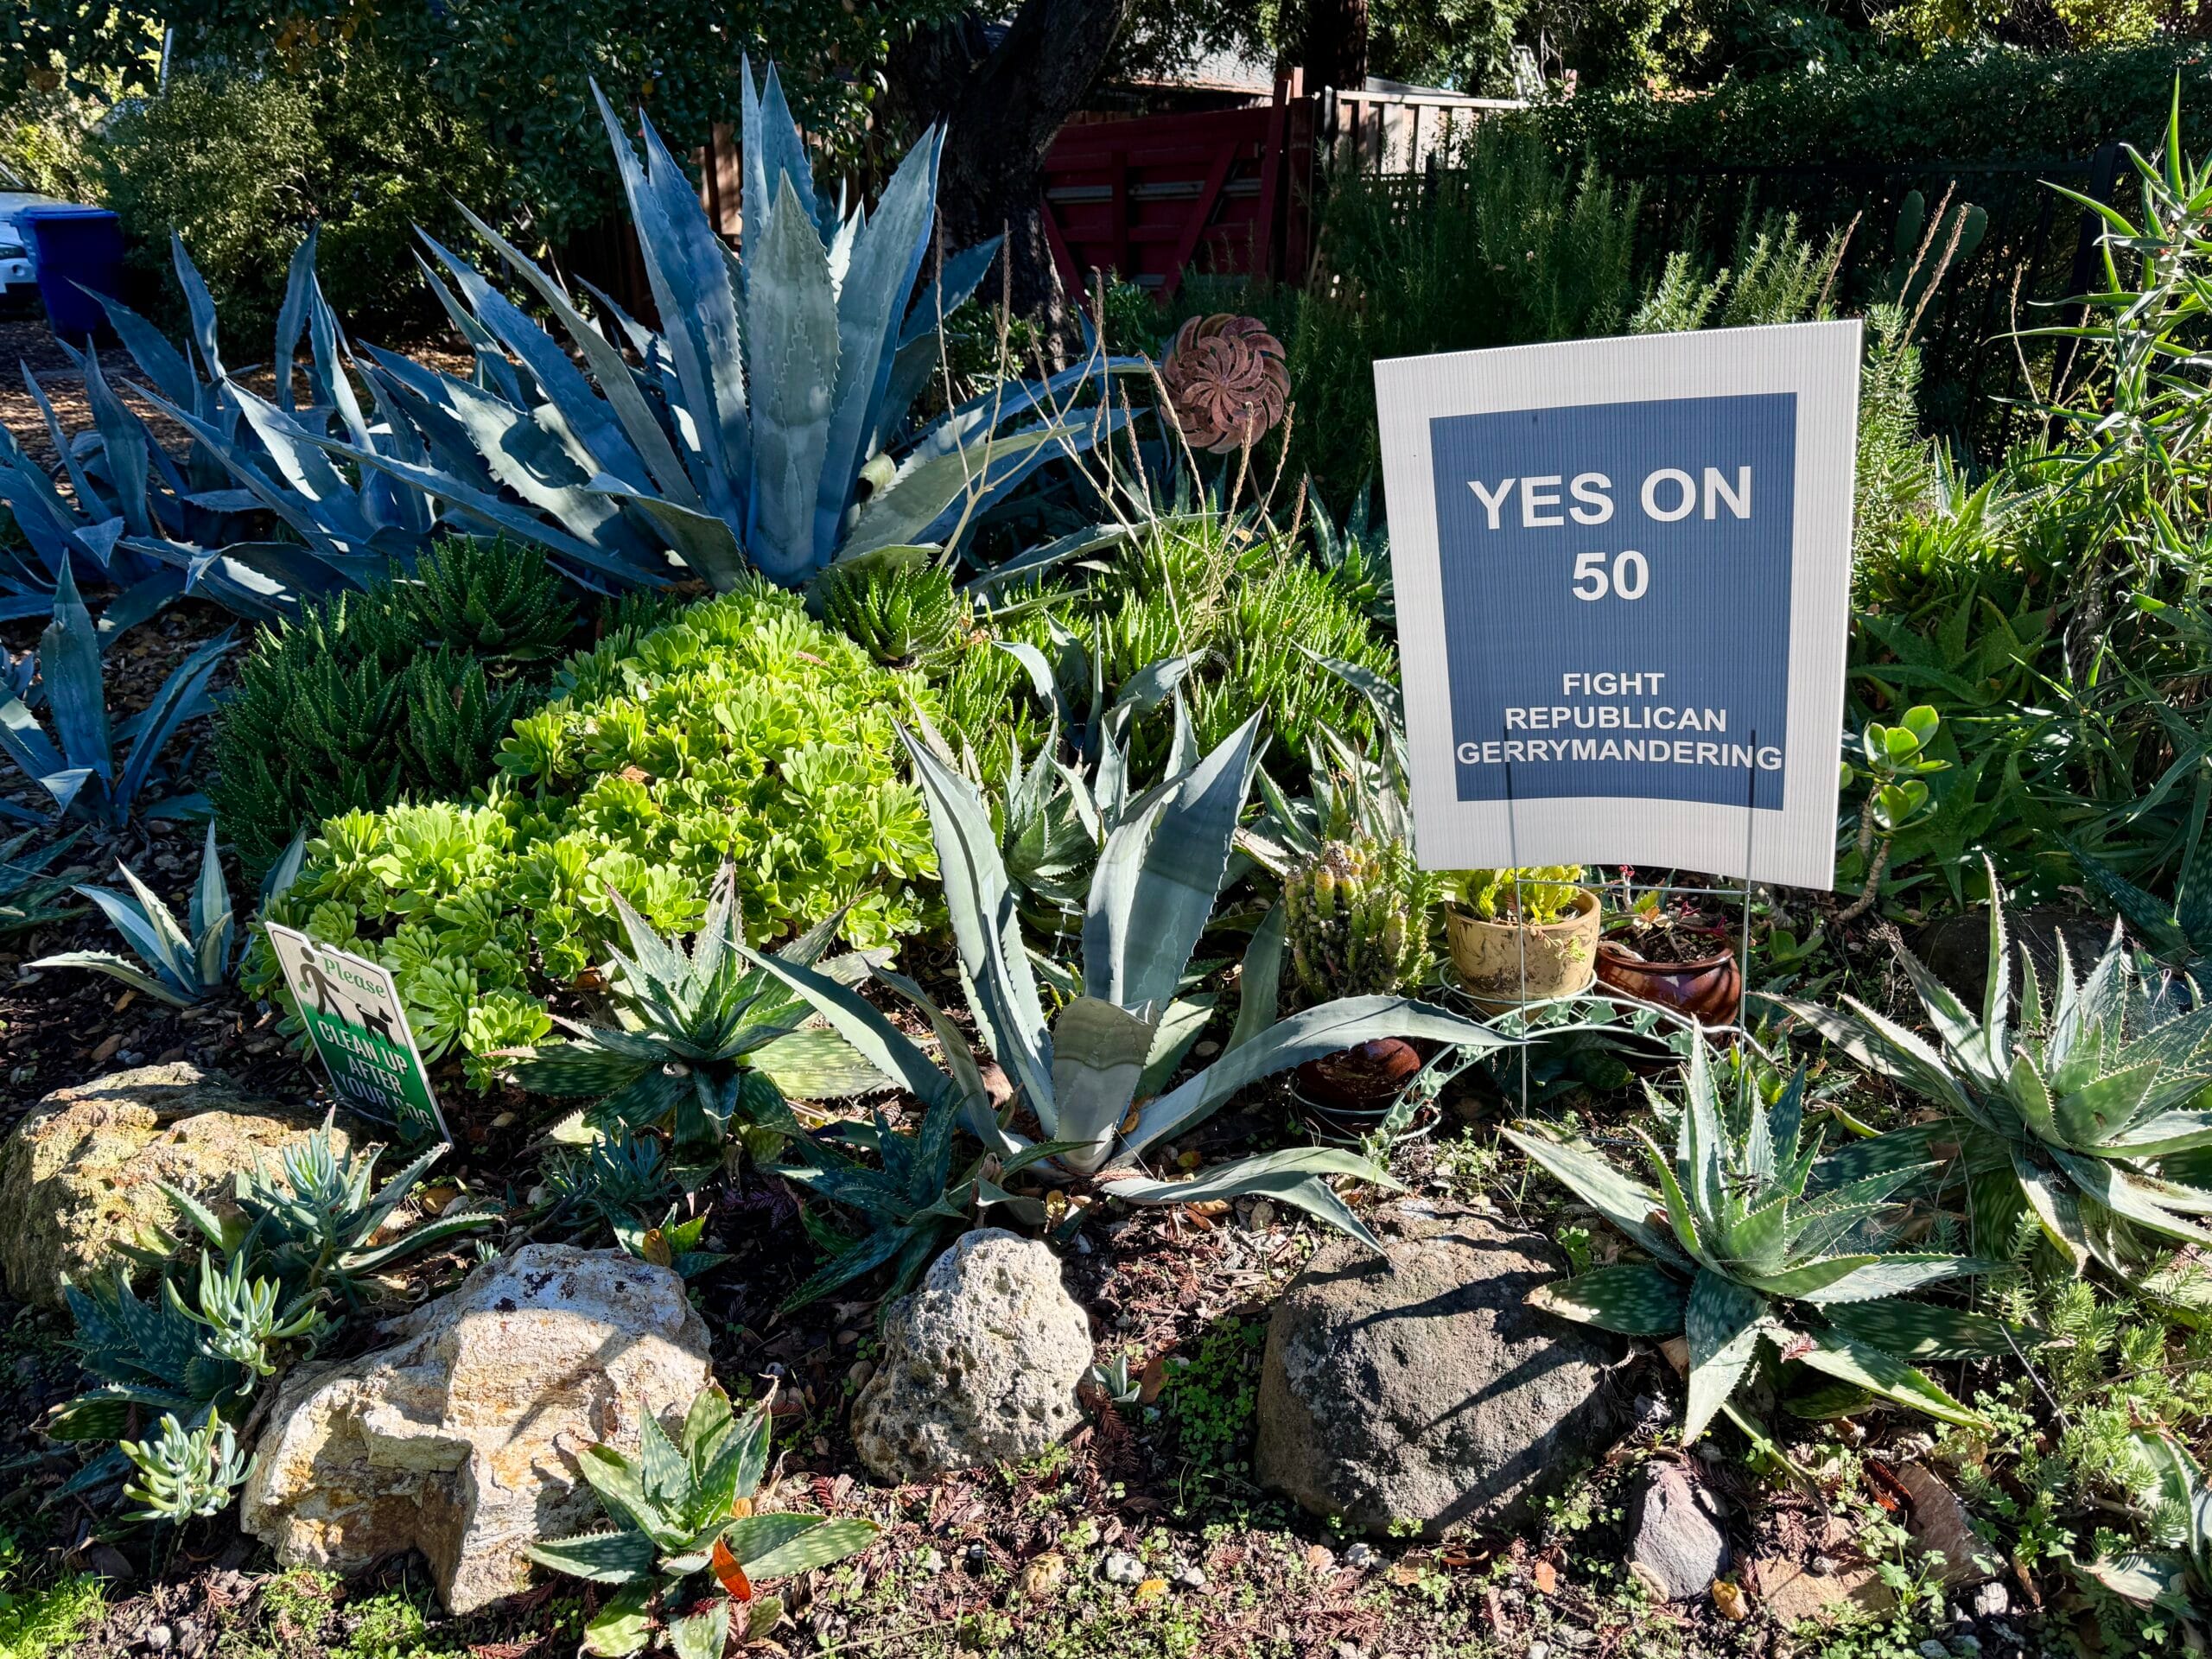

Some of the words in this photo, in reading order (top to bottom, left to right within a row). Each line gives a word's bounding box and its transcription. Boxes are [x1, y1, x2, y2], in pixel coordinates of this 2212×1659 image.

[1467, 472, 1614, 530] YES
[1641, 466, 1751, 522] ON
[1572, 550, 1649, 601] 50
[1563, 672, 1665, 696] FIGHT
[1505, 706, 1726, 732] REPUBLICAN
[1457, 739, 1783, 771] GERRYMANDERING
[323, 957, 386, 999] Please
[317, 1020, 379, 1064] CLEAN
[380, 1046, 408, 1075] UP
[335, 1070, 391, 1110] YOUR
[347, 1054, 405, 1096] AFTER
